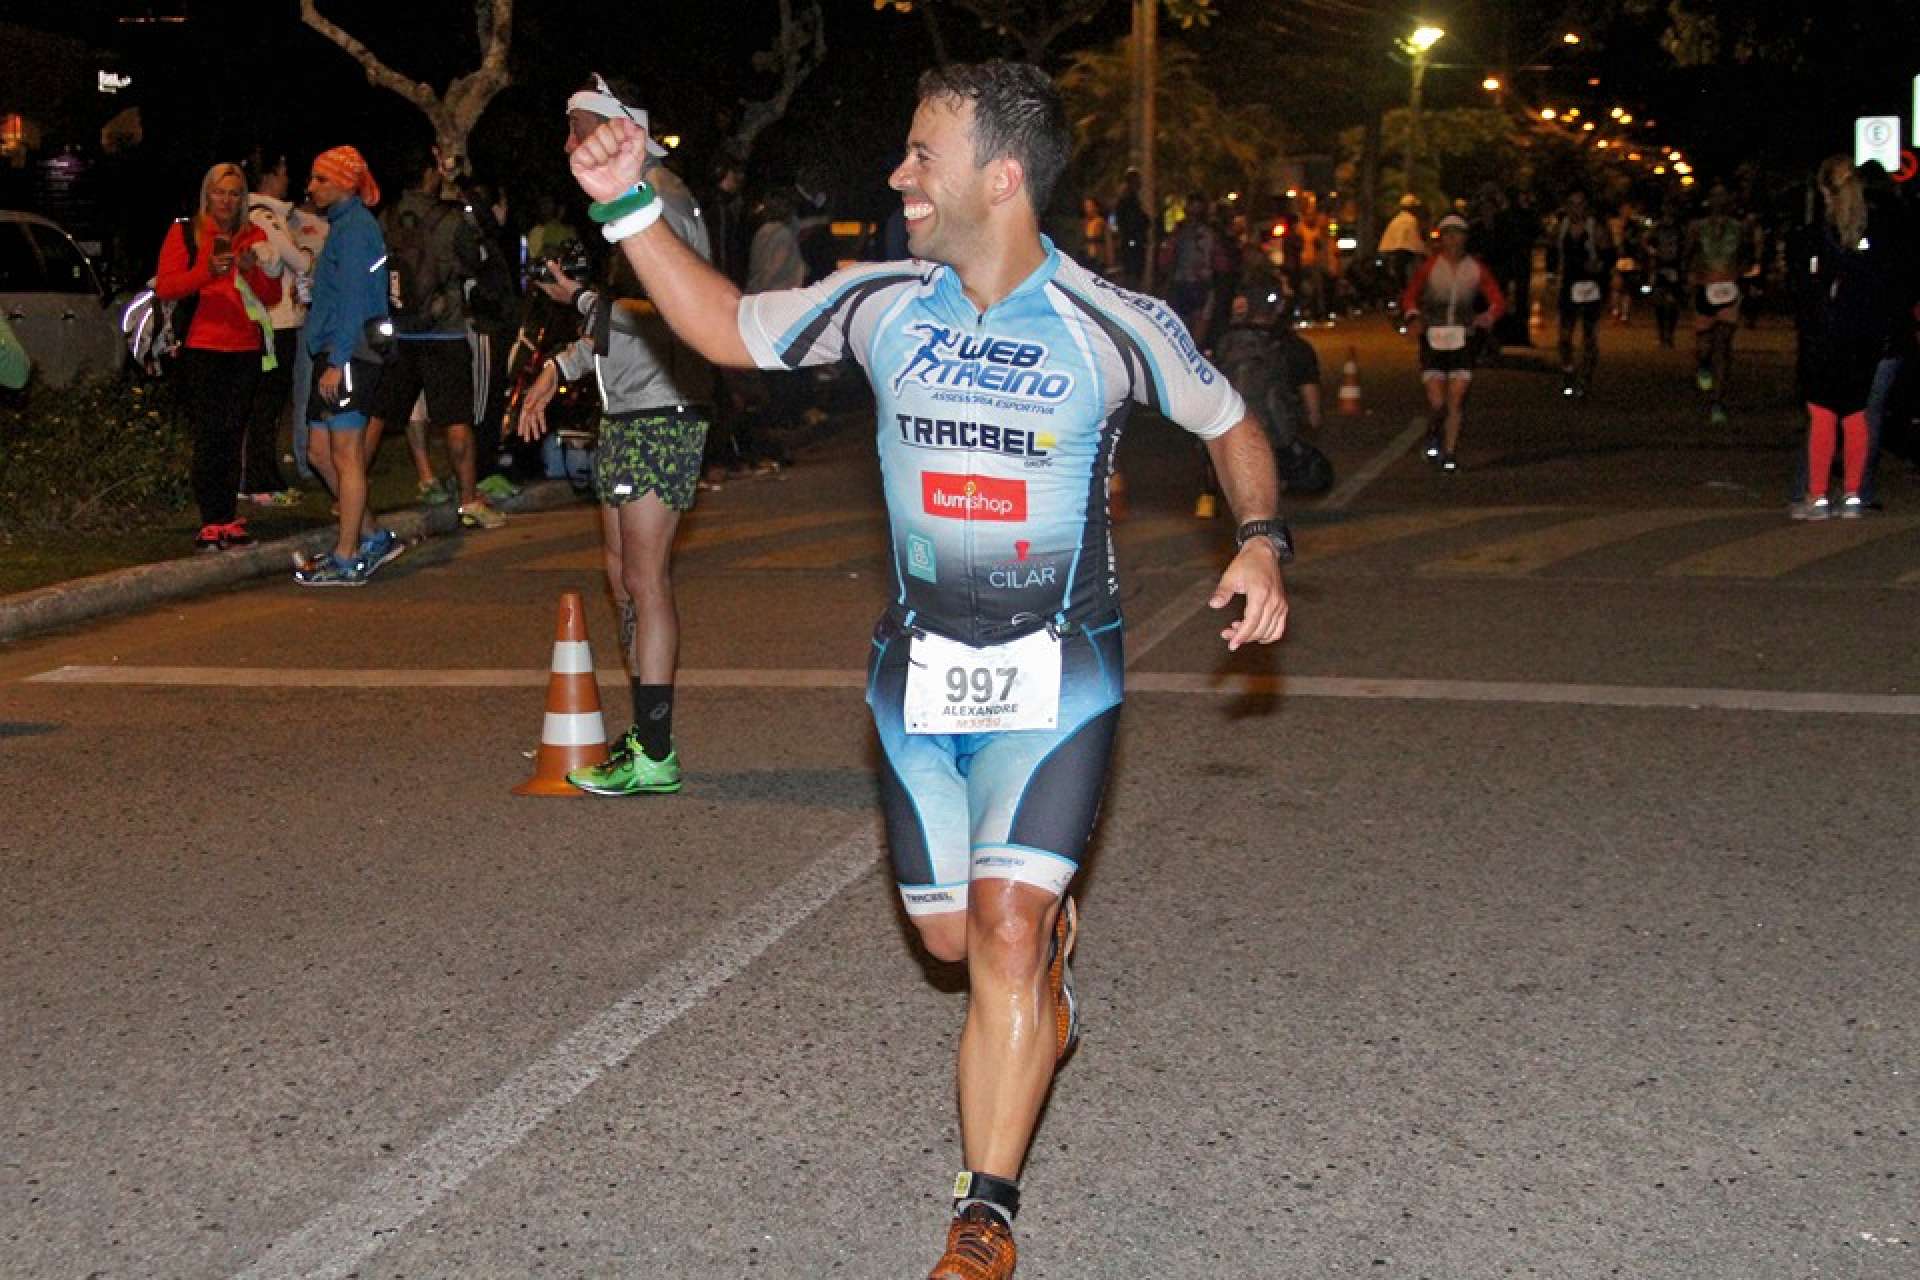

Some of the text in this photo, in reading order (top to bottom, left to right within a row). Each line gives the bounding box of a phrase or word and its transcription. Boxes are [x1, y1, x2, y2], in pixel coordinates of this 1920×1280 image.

[958, 335, 1045, 368] WEB
[936, 359, 1071, 398] TREINO
[896, 414, 1047, 457] TRACBEL
[989, 567, 1057, 589] CILAR
[946, 666, 1019, 703] 997
[943, 703, 1019, 717] ALEXANDRE
